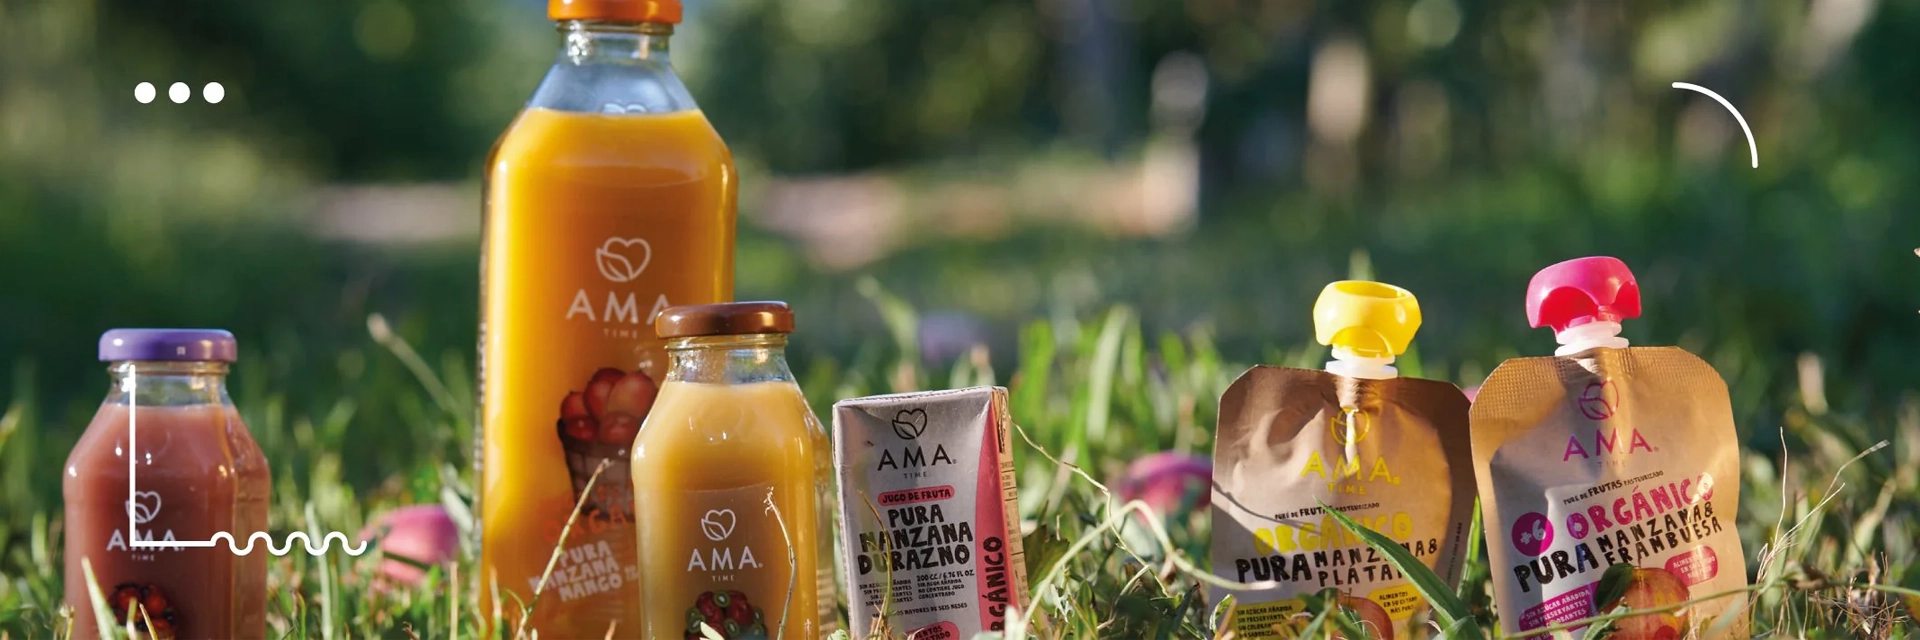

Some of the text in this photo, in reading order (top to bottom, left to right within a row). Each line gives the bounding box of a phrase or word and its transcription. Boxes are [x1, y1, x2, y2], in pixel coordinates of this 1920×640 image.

[603, 328, 638, 339] TIME
[877, 444, 952, 472] AMA
[1563, 427, 1653, 462] AMA
[1300, 451, 1392, 483] AMA
[882, 488, 951, 503] JUGO DE FRUTA
[1327, 482, 1366, 496] TIME
[1580, 492, 1588, 500] DE
[1587, 479, 1623, 497] FRUTAS
[1623, 470, 1664, 486] PASTEURIZADO
[887, 504, 945, 528] PURA
[1299, 506, 1334, 517] FRUT
[106, 529, 179, 551] AMA
[859, 521, 973, 553] MANZANA
[1519, 519, 1546, 545] +6
[1603, 516, 1723, 566] FRAMBUESA
[559, 539, 614, 567] PURA
[687, 545, 759, 572] AMA
[858, 544, 971, 575] DURAZNO
[916, 574, 929, 582] 200
[1235, 552, 1312, 583] PURA
[1318, 559, 1403, 587] PLÁTA
[1513, 542, 1600, 593] PURA
[558, 573, 623, 602] MANGO
[918, 591, 956, 600] CONCENTRADO
[982, 536, 1009, 631] RGÁNICO
[905, 607, 930, 615] MAYORES
[914, 624, 943, 639] MENTOS
